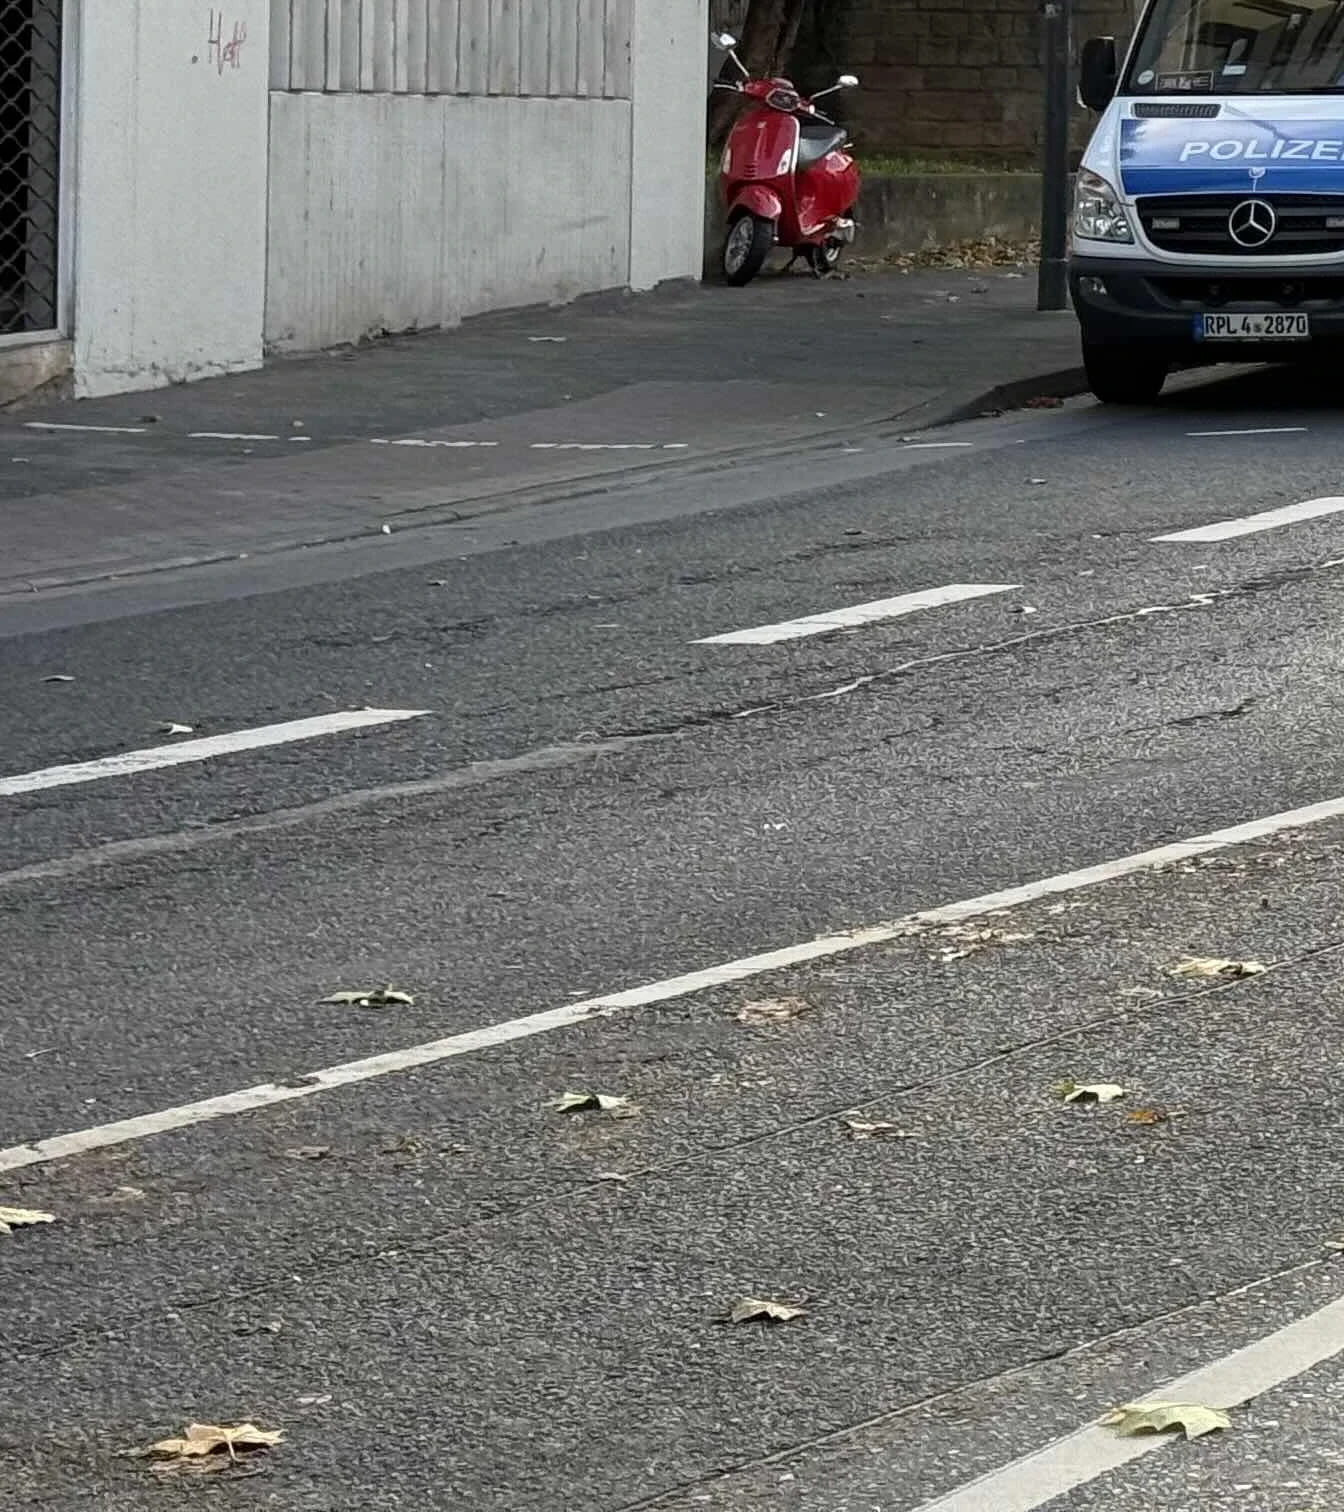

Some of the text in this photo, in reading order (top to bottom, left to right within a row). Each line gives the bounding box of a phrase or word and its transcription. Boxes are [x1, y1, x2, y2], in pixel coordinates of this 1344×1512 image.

[1205, 315, 1306, 335] RPL 4 2870
